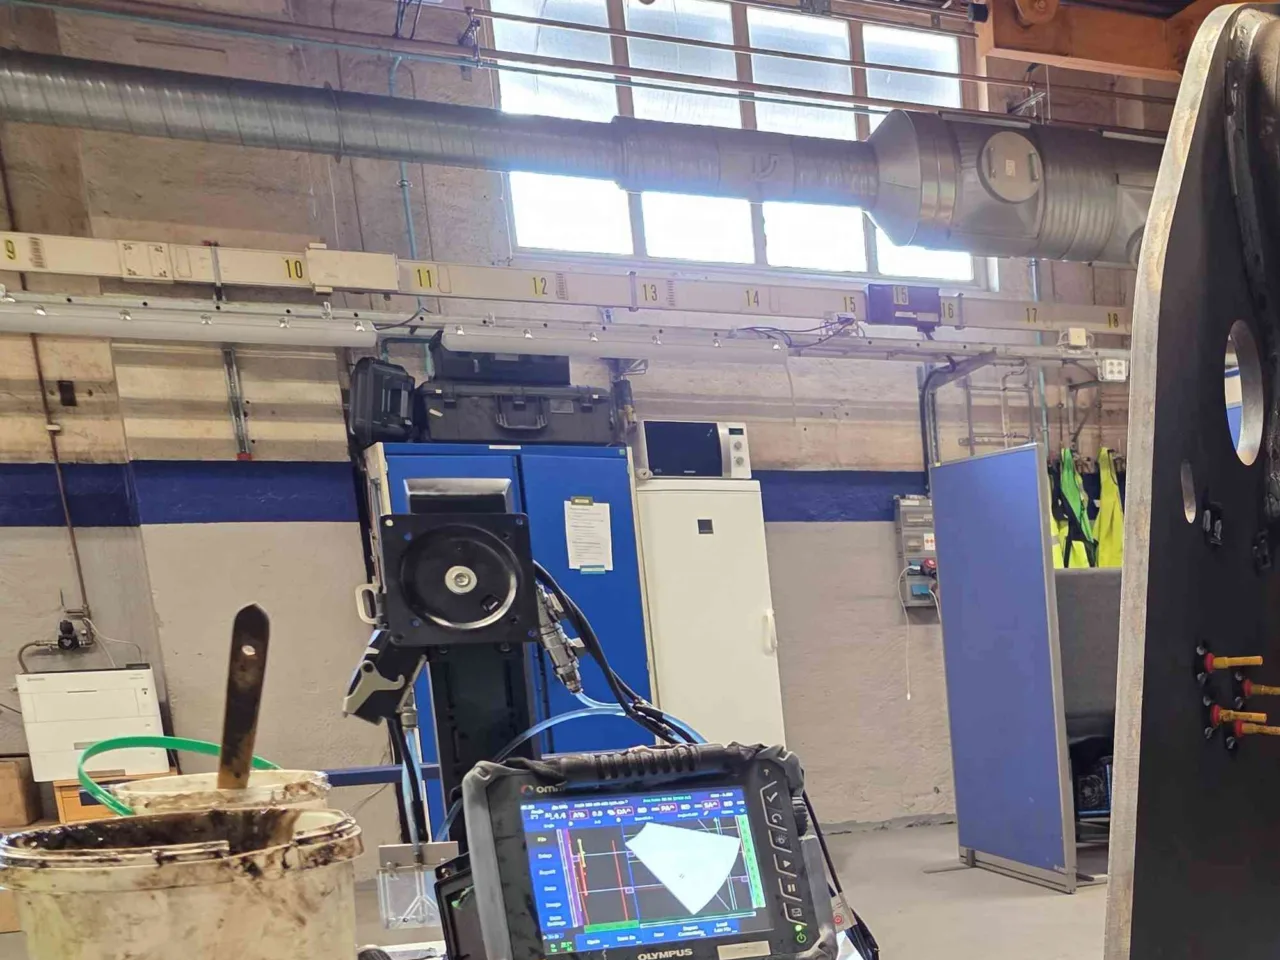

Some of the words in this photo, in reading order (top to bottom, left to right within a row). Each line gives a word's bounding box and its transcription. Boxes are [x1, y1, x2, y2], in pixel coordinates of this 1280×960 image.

[4, 239, 16, 260] 9
[285, 259, 304, 279] 10
[417, 268, 432, 288] 11
[532, 277, 548, 296] 12
[643, 284, 658, 302] 13
[746, 290, 760, 307] 14
[843, 296, 856, 313] 15
[942, 302, 954, 319] 16
[1026, 307, 1038, 324] 17
[1107, 312, 1119, 329] 18
